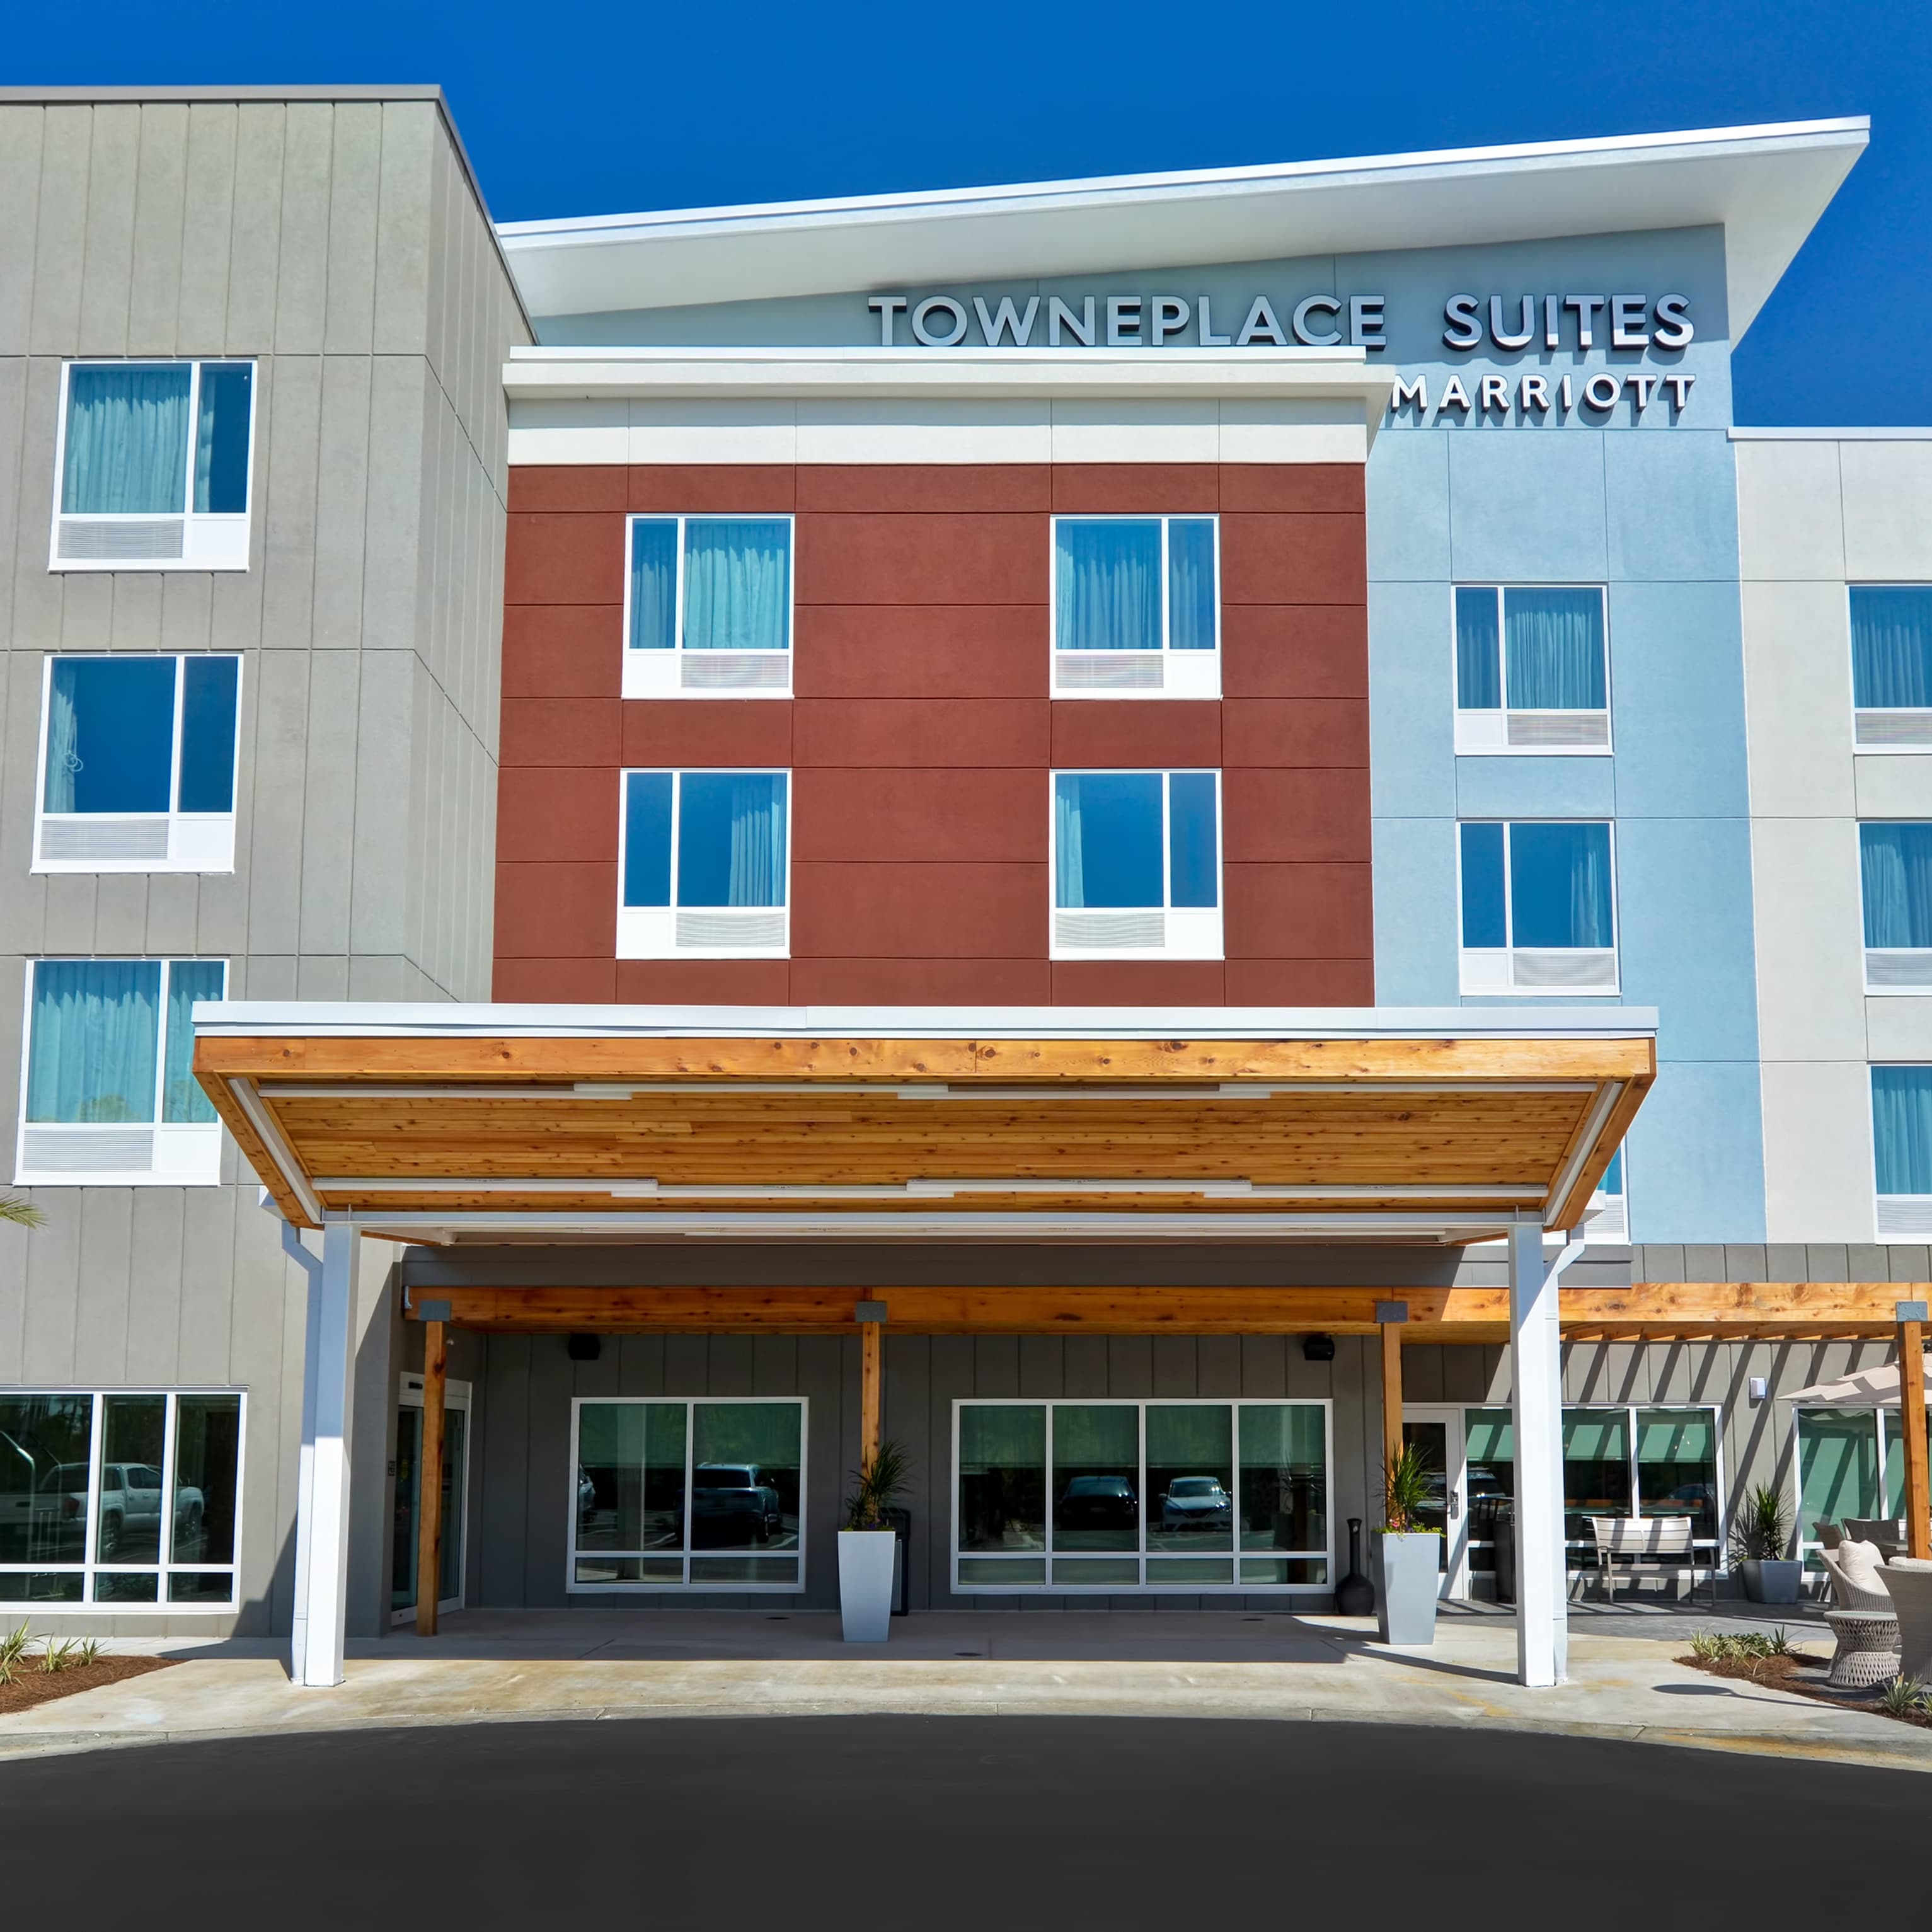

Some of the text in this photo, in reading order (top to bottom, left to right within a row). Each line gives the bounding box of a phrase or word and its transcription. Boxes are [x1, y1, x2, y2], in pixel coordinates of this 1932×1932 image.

[868, 293, 1695, 351] TOWNEPLACE SUITES
[1391, 372, 1696, 413] MARRIOTT
